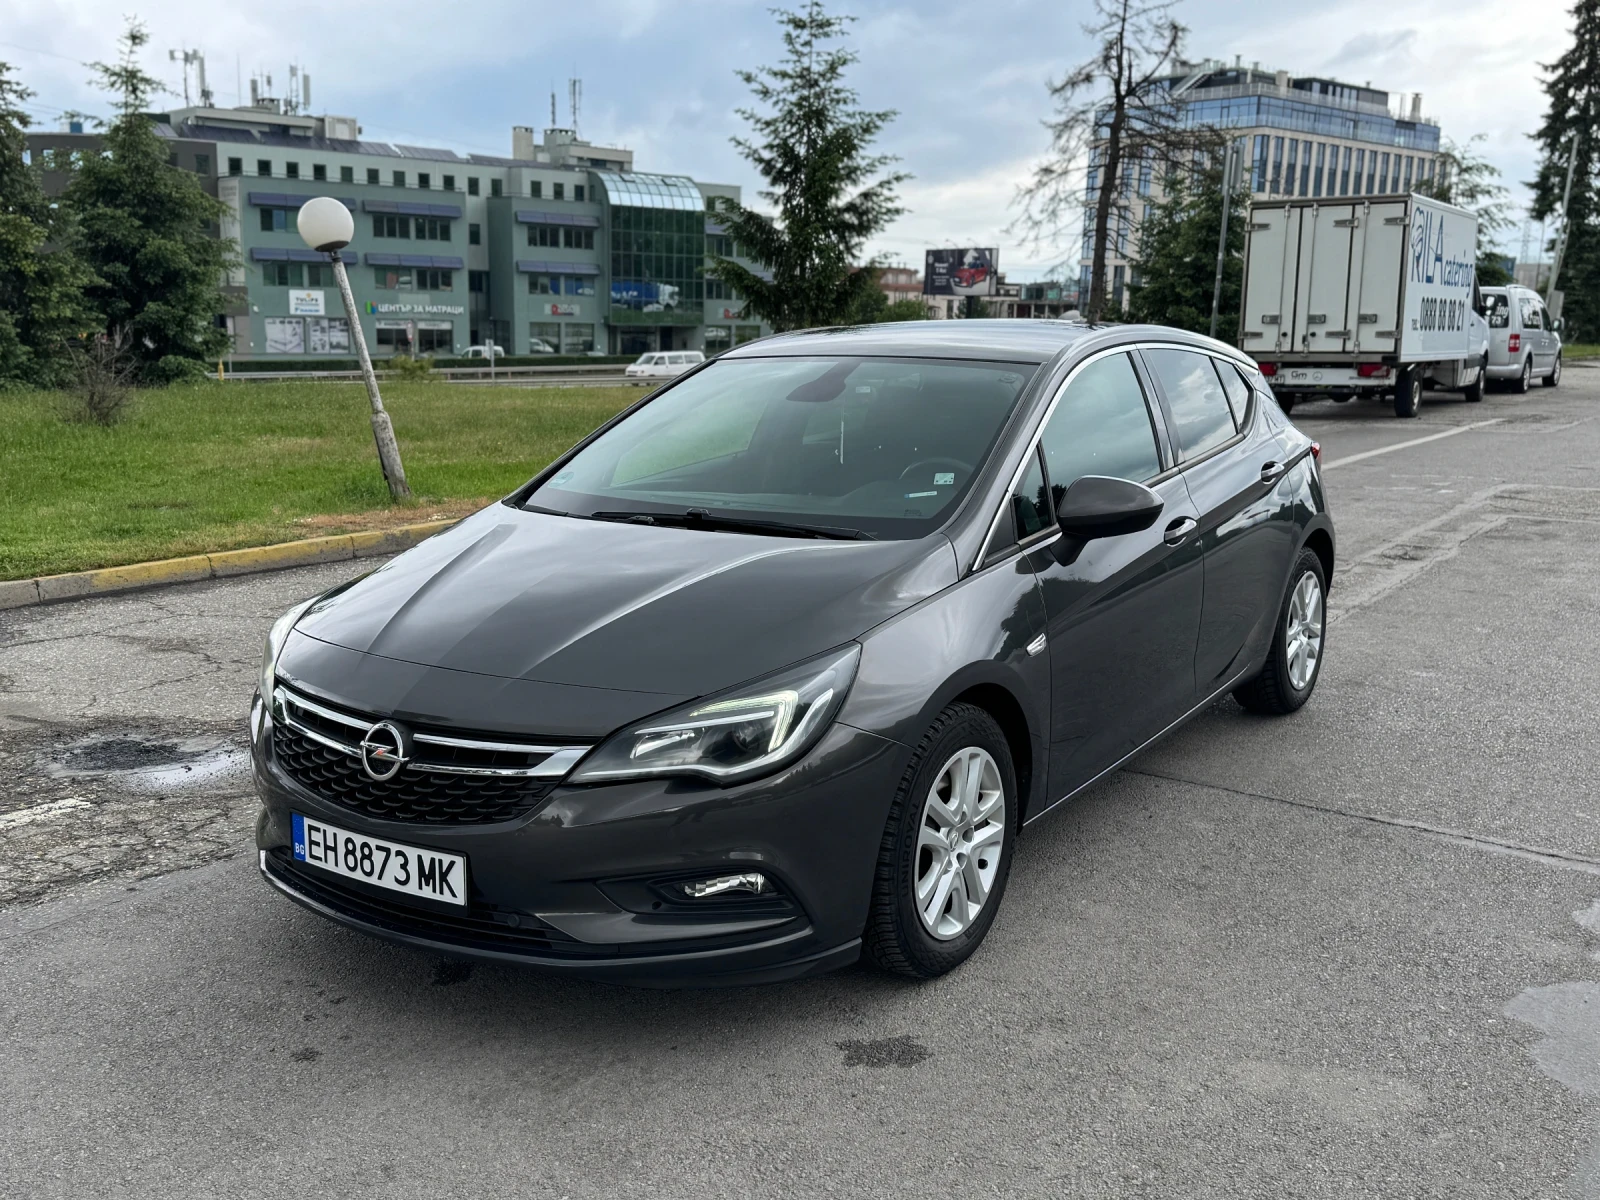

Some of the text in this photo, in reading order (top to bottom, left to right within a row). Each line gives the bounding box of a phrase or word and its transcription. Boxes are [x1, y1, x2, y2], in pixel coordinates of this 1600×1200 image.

[1411, 206, 1443, 285] RILA
[1443, 250, 1473, 299] catering
[378, 303, 464, 315] ЦЕНТЪР ЗА МАТРАЦИ
[295, 843, 305, 855] BG
[308, 824, 458, 899] EH 8873 MK
[901, 803, 920, 898] UNIROYAL
